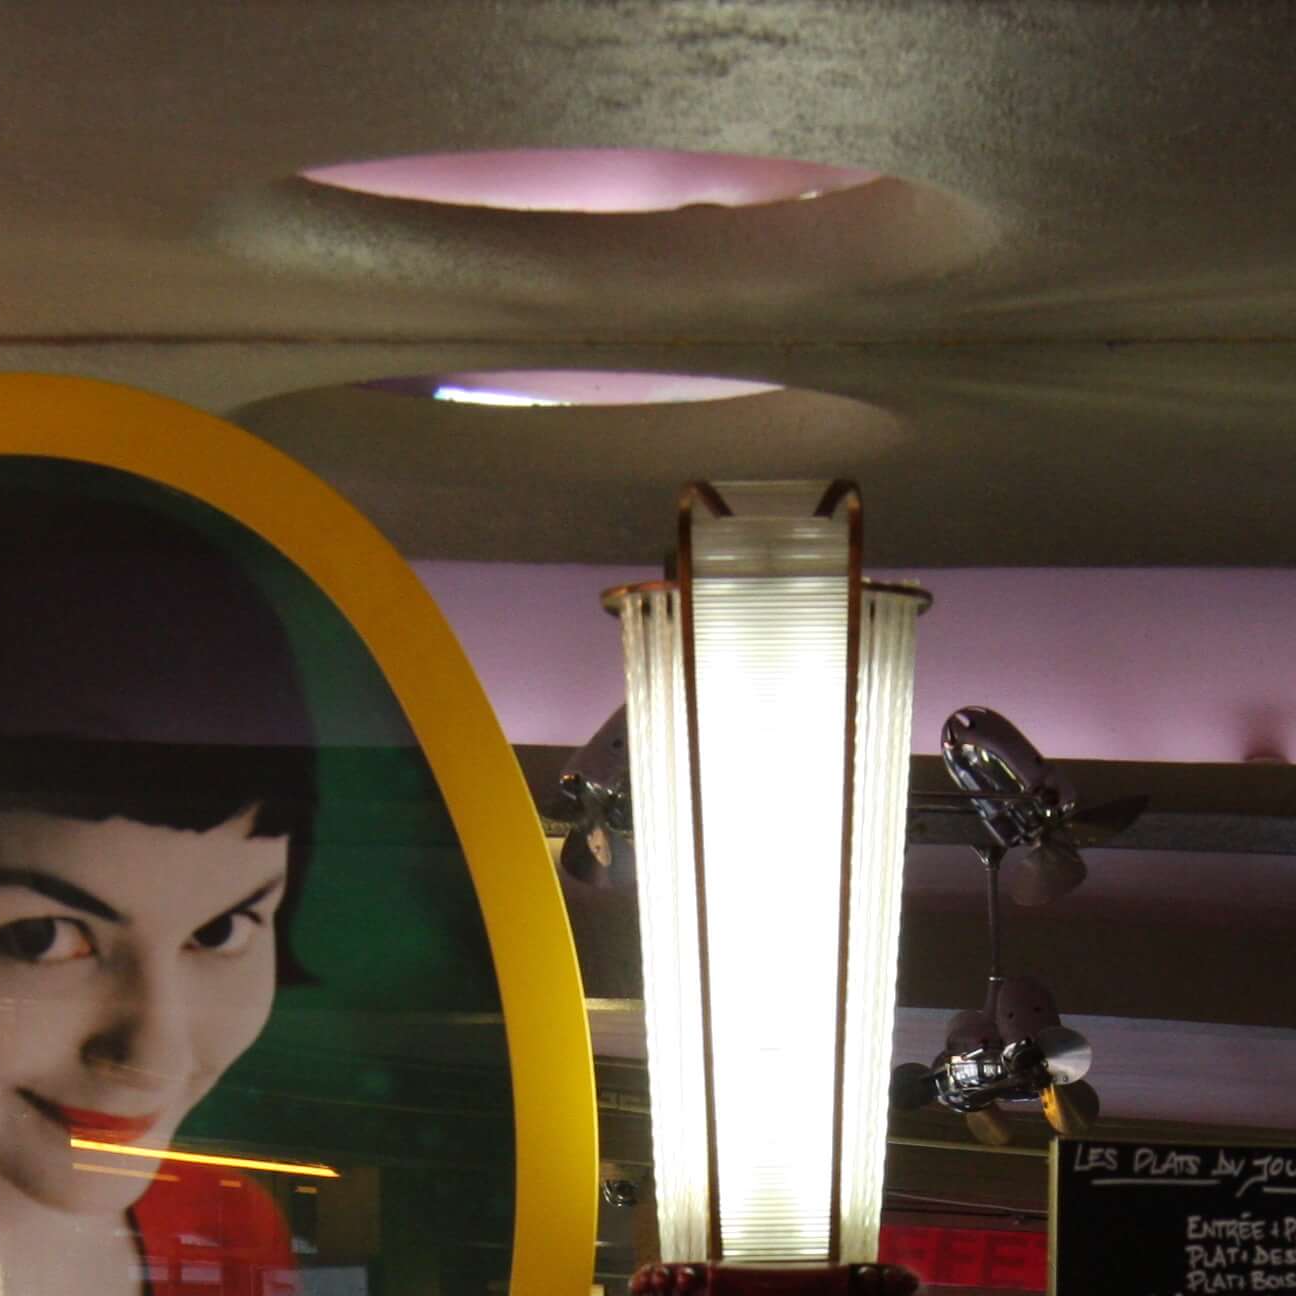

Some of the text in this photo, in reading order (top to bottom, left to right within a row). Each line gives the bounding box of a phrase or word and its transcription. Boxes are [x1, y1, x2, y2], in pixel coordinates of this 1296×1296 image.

[1072, 1144, 1119, 1173] LES
[1132, 1147, 1203, 1176] PLATS
[1210, 1149, 1247, 1177] DU
[1185, 1211, 1266, 1246] ENTRÉE
